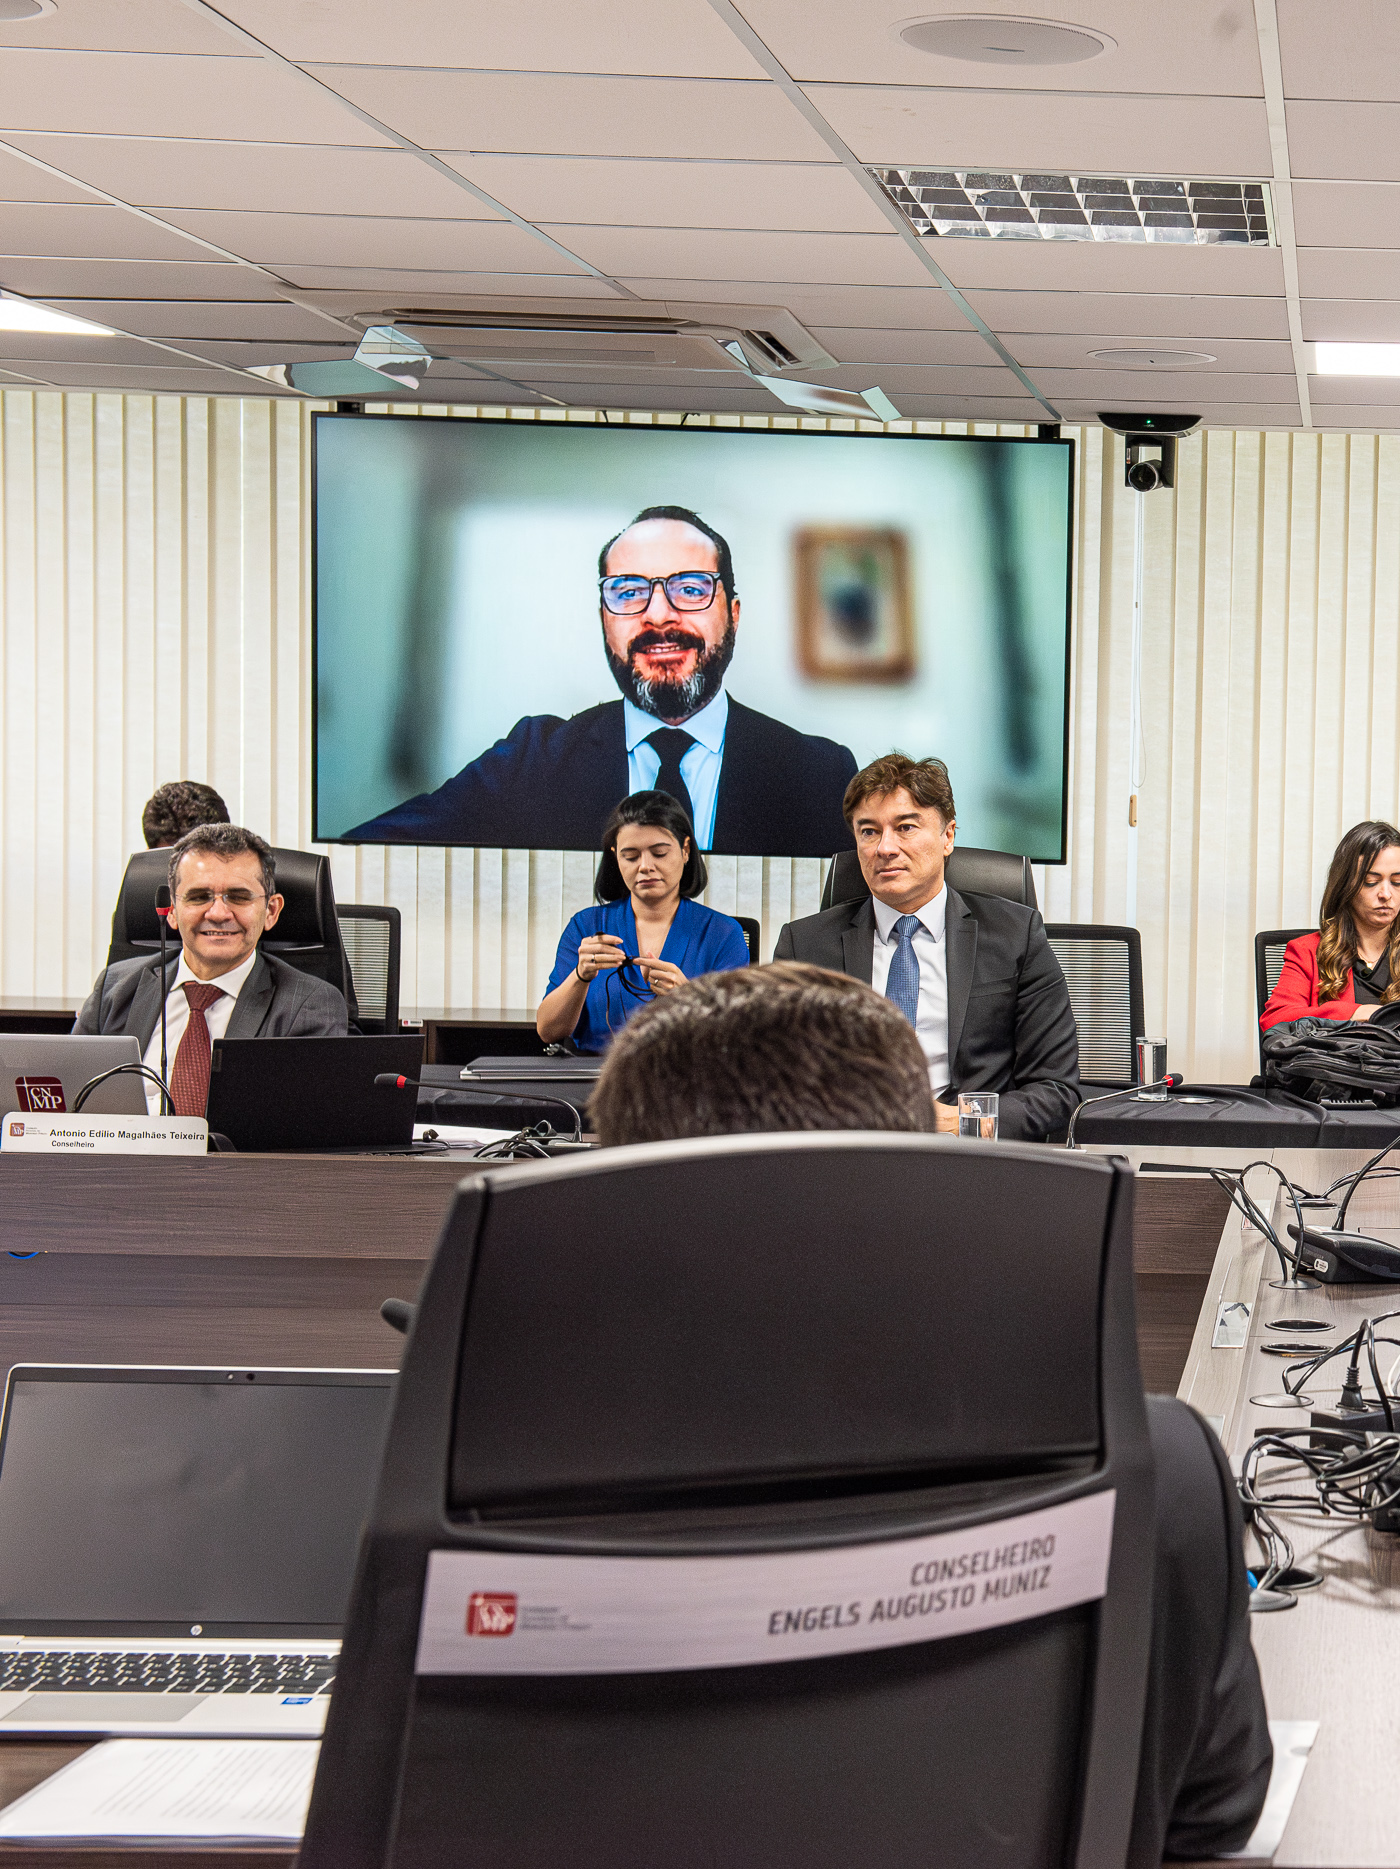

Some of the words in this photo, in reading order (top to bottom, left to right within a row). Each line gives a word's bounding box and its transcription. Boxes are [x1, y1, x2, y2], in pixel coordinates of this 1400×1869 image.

[33, 1095, 63, 1109] MP
[50, 1129, 86, 1138] Antonio
[118, 1131, 167, 1141] Magalhães
[170, 1131, 205, 1141] Teixeira
[51, 1140, 95, 1148] Conselheiro
[910, 1534, 1057, 1587] CONSELHEIRO
[767, 1601, 862, 1636] ENGELS
[868, 1585, 976, 1623] AUGUSTO
[981, 1564, 1053, 1603] MUNIZ
